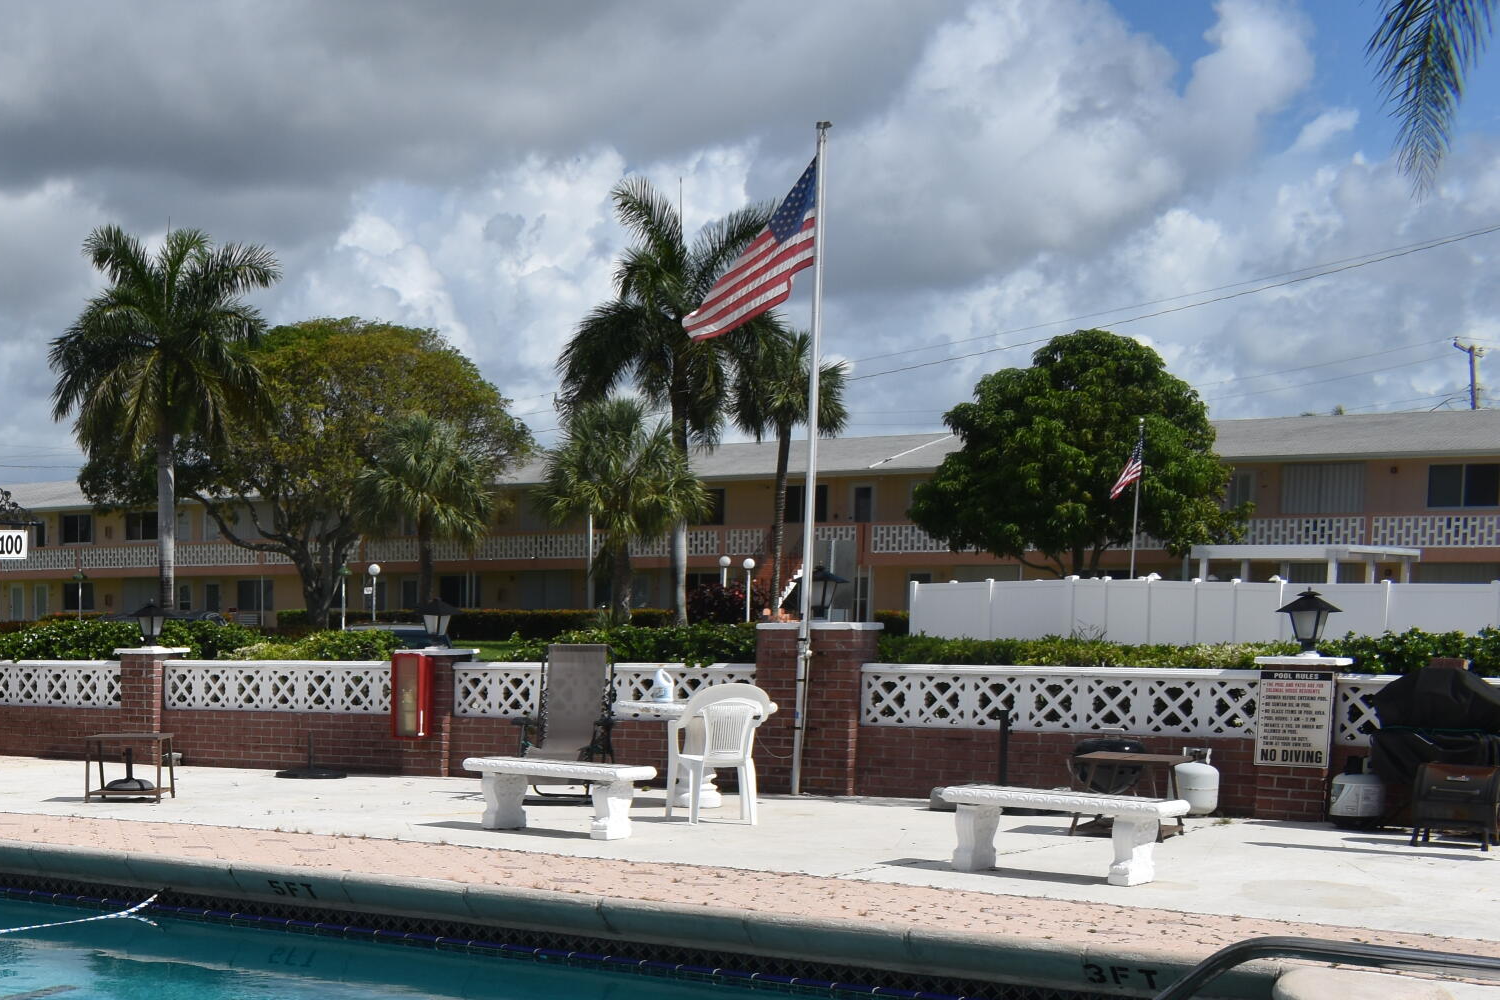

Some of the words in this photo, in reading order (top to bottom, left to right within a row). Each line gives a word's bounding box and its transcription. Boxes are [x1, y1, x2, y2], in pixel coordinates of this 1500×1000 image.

[1260, 749, 1276, 762] NO
[1282, 750, 1322, 764] DIVING
[268, 880, 318, 900] 5FT
[1082, 964, 1158, 990] 3FT
